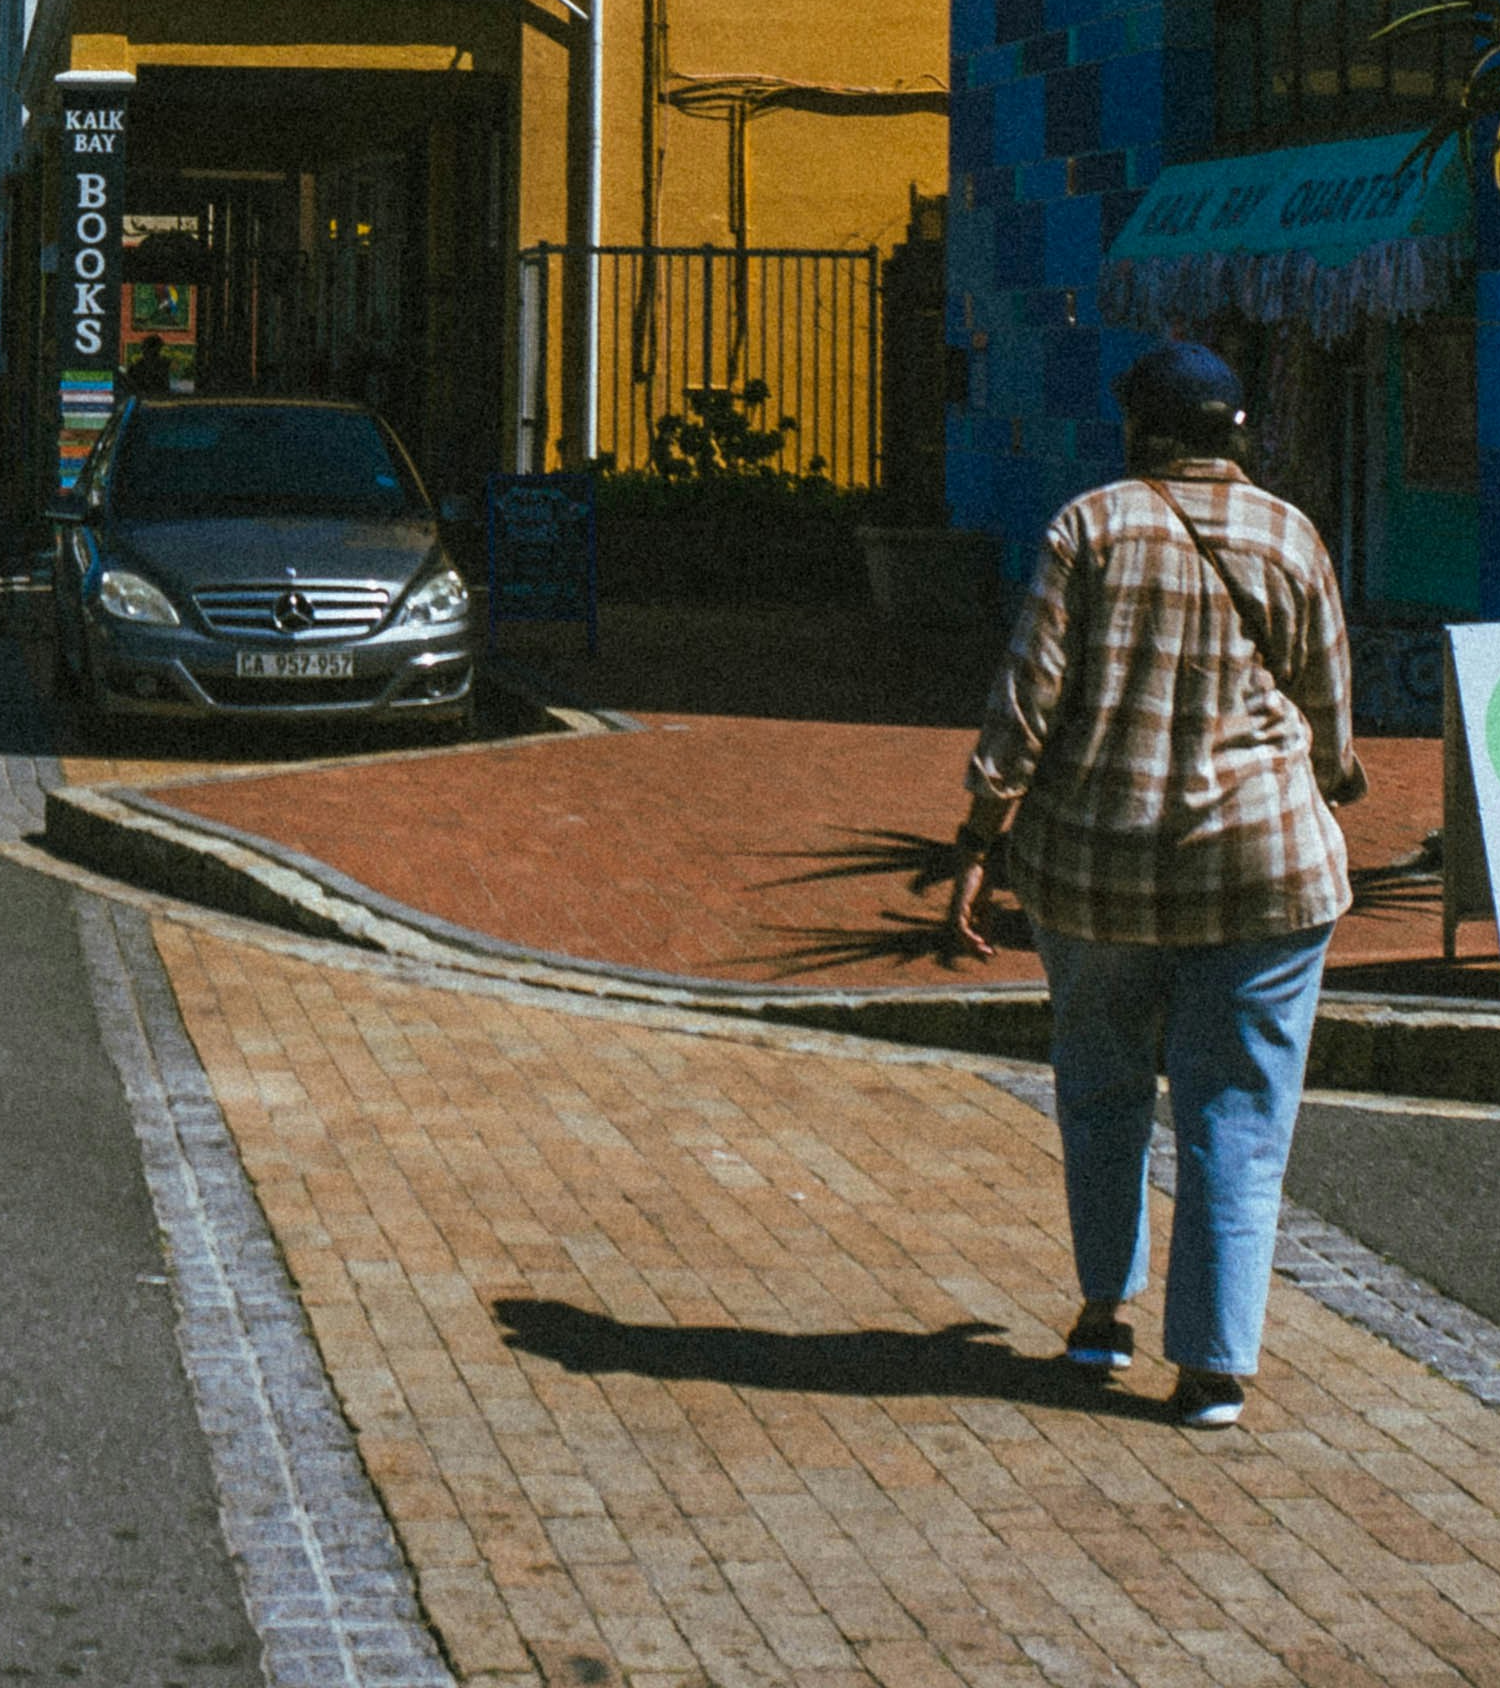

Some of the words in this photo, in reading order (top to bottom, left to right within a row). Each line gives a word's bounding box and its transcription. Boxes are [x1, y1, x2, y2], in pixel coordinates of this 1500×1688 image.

[65, 109, 125, 130] KALK
[74, 133, 116, 153] BAY
[73, 173, 107, 354] BOOKS
